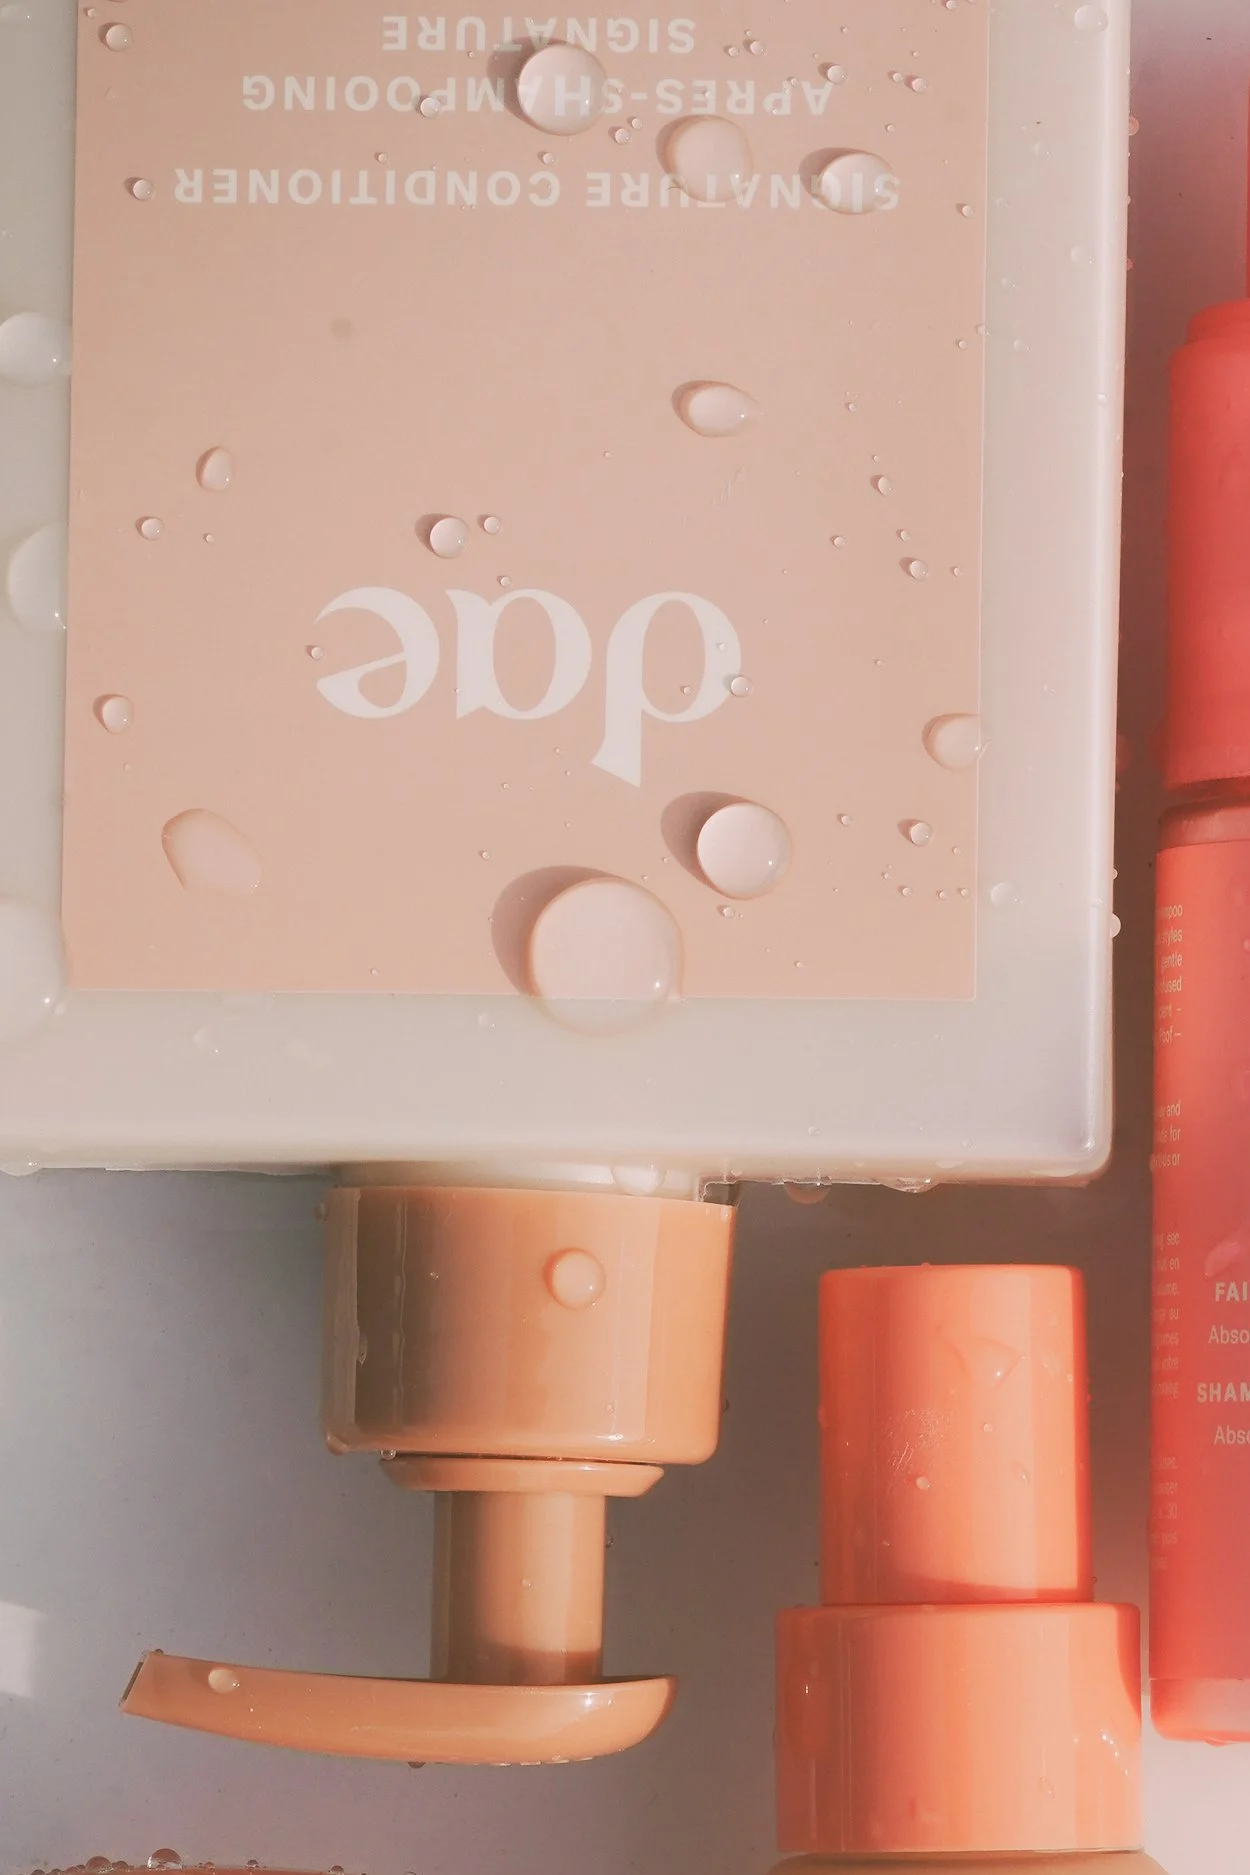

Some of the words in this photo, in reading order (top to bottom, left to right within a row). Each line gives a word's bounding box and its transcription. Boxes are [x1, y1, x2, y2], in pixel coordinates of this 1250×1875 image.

[382, 16, 695, 53] SIGNATURE
[173, 168, 561, 207] CONDITIONER
[586, 171, 900, 211] SIGNATURE
[314, 586, 743, 789] dae
